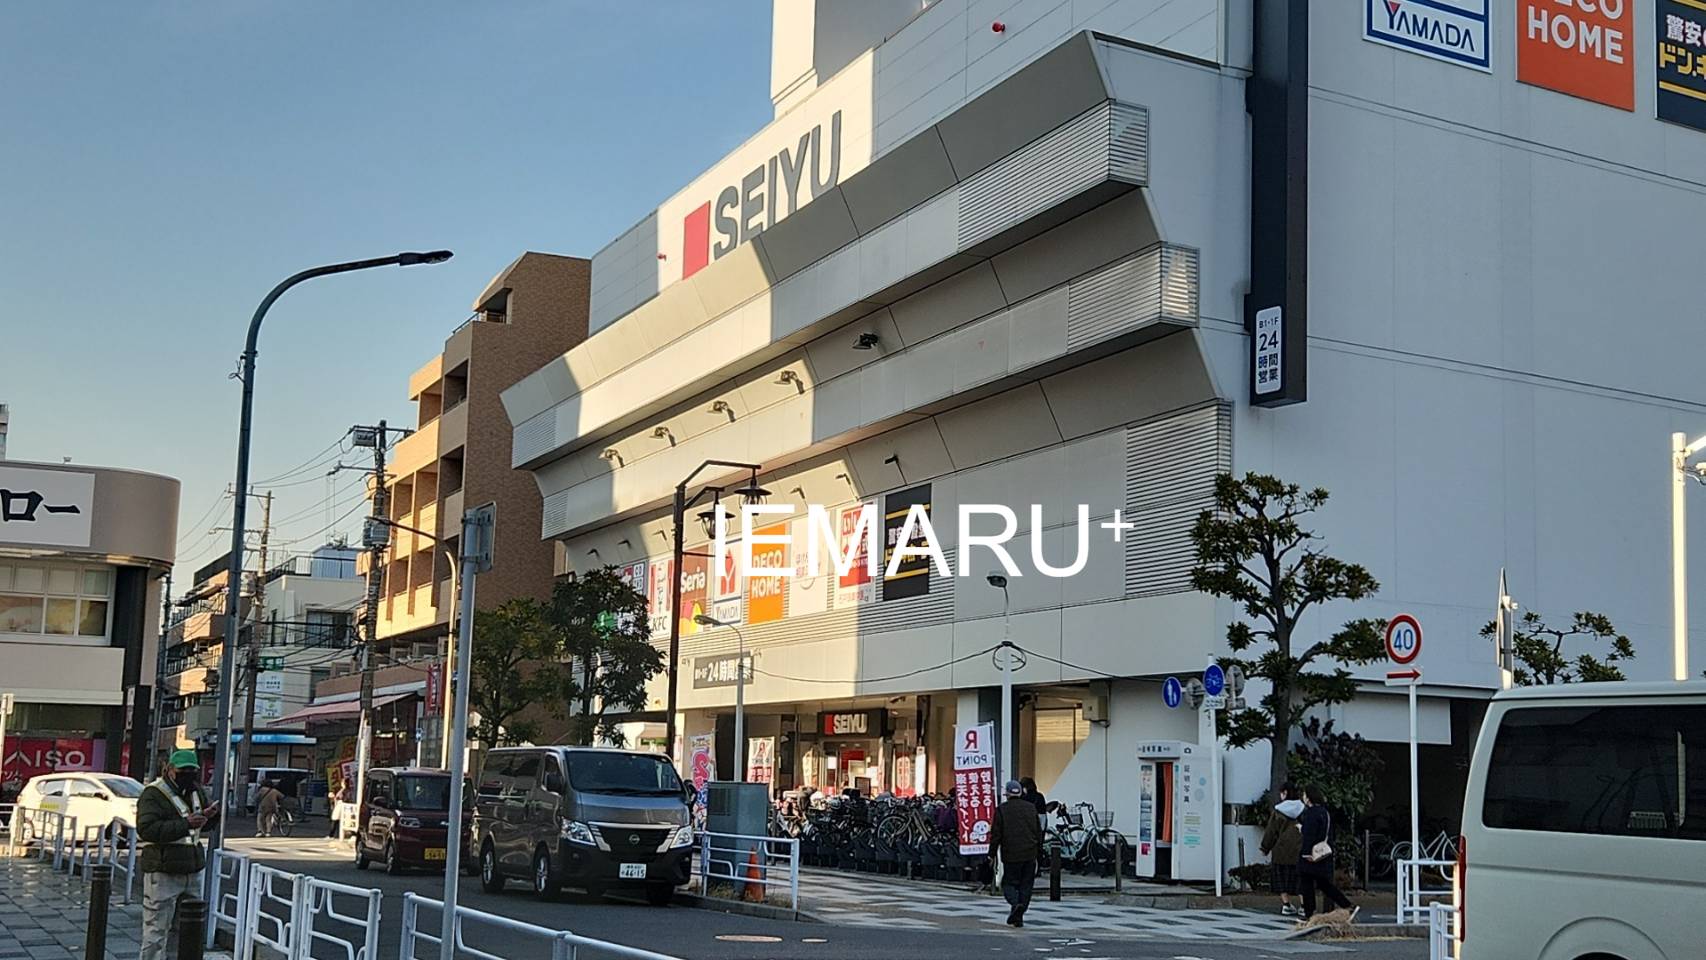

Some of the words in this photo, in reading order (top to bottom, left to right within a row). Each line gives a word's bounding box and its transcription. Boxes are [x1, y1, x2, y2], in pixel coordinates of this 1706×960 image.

[1383, 0, 1475, 52] YAMADA
[1527, 5, 1624, 64] HOME
[1666, 14, 1706, 48] 驚安
[713, 110, 842, 260] SEIYU
[1258, 330, 1279, 352] 24
[1258, 353, 1279, 369] 時間
[1258, 367, 1279, 384] 営業
[0, 488, 81, 522] ロー
[680, 566, 706, 594] Seria
[750, 577, 782, 599] HOME
[1393, 628, 1413, 651] 40
[833, 713, 868, 735] SEIYU
